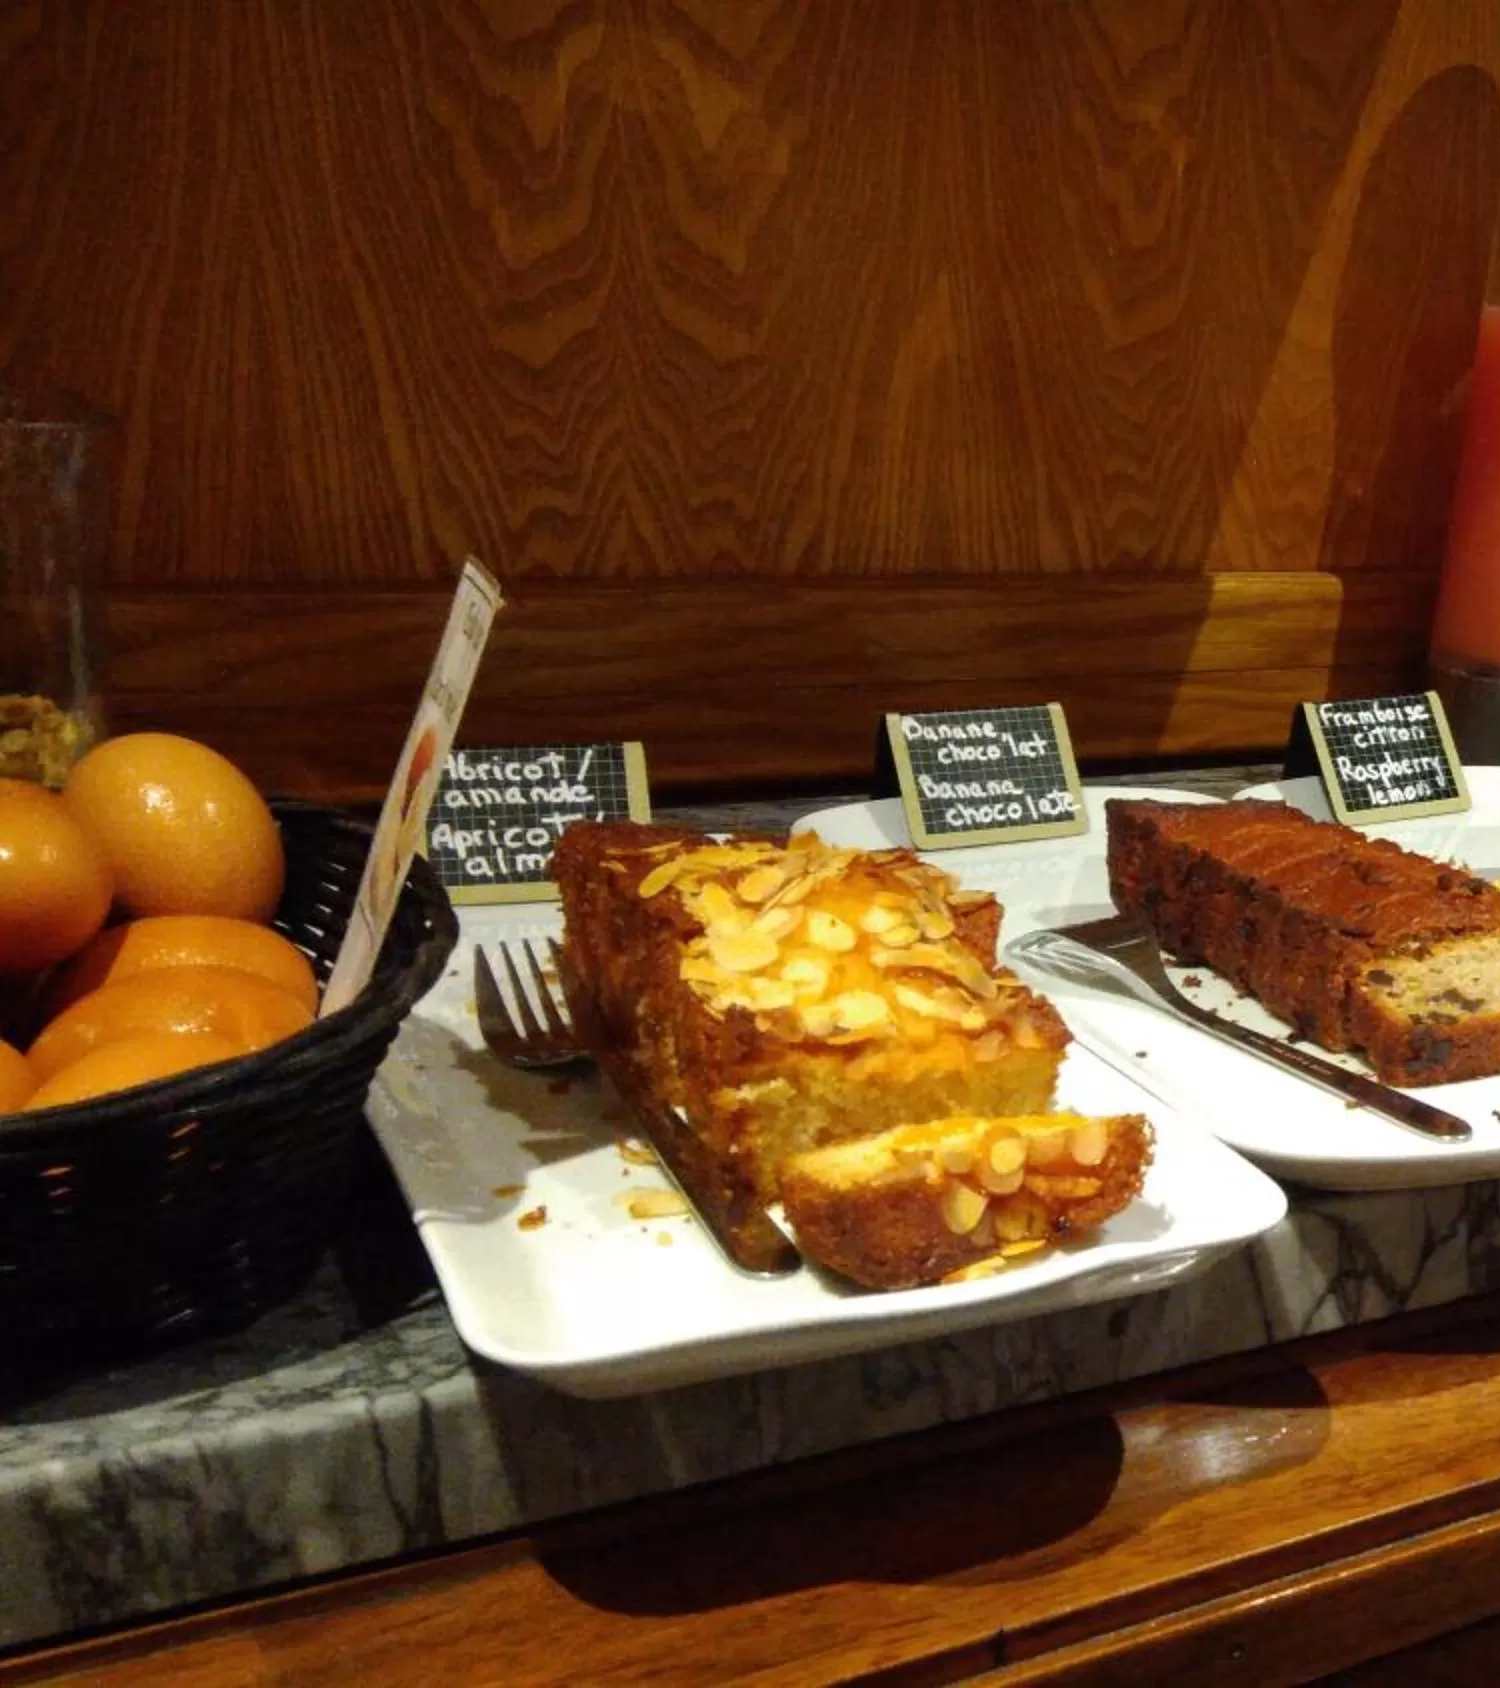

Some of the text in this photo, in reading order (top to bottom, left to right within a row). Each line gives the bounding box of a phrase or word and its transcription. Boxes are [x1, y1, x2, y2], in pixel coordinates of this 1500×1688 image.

[1319, 698, 1430, 727] Framboise
[1354, 725, 1426, 748] citron
[1336, 751, 1446, 788] Raspberry
[444, 780, 596, 809] amande
[918, 774, 1025, 799] Banana
[1367, 780, 1432, 804] lemon
[464, 846, 556, 877] alm
